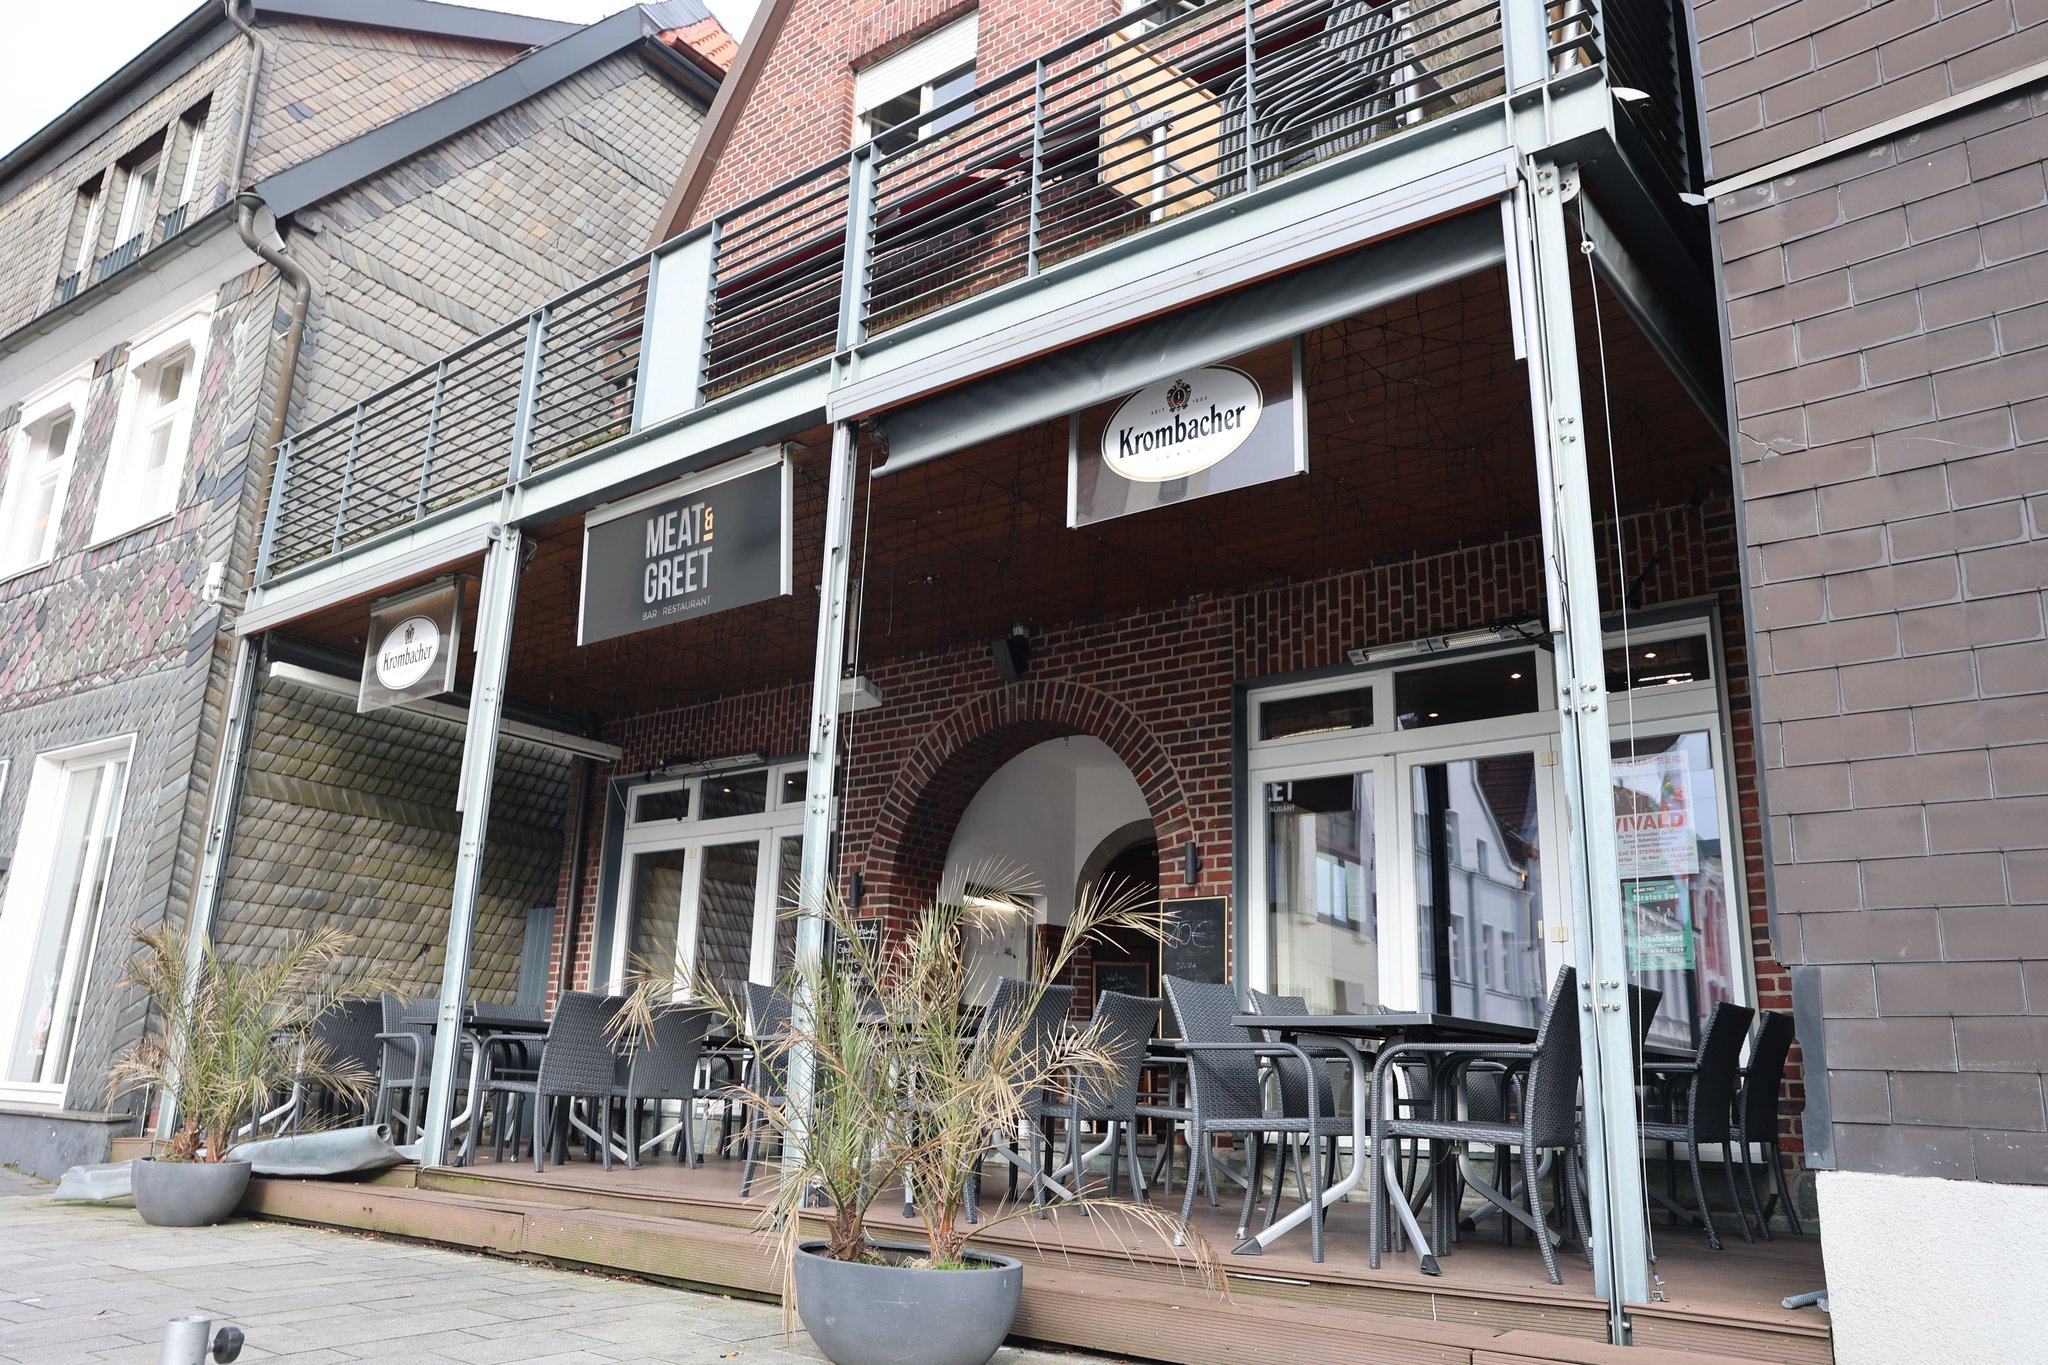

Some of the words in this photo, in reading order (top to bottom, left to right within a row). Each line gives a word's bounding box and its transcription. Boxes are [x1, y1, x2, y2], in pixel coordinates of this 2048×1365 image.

[1119, 404, 1246, 458] Krombacher
[645, 502, 705, 559] MEAT
[644, 546, 713, 604] GREET
[642, 610, 657, 621] BAR
[662, 595, 712, 615] RESTAURANT
[383, 643, 433, 672] Krombacher
